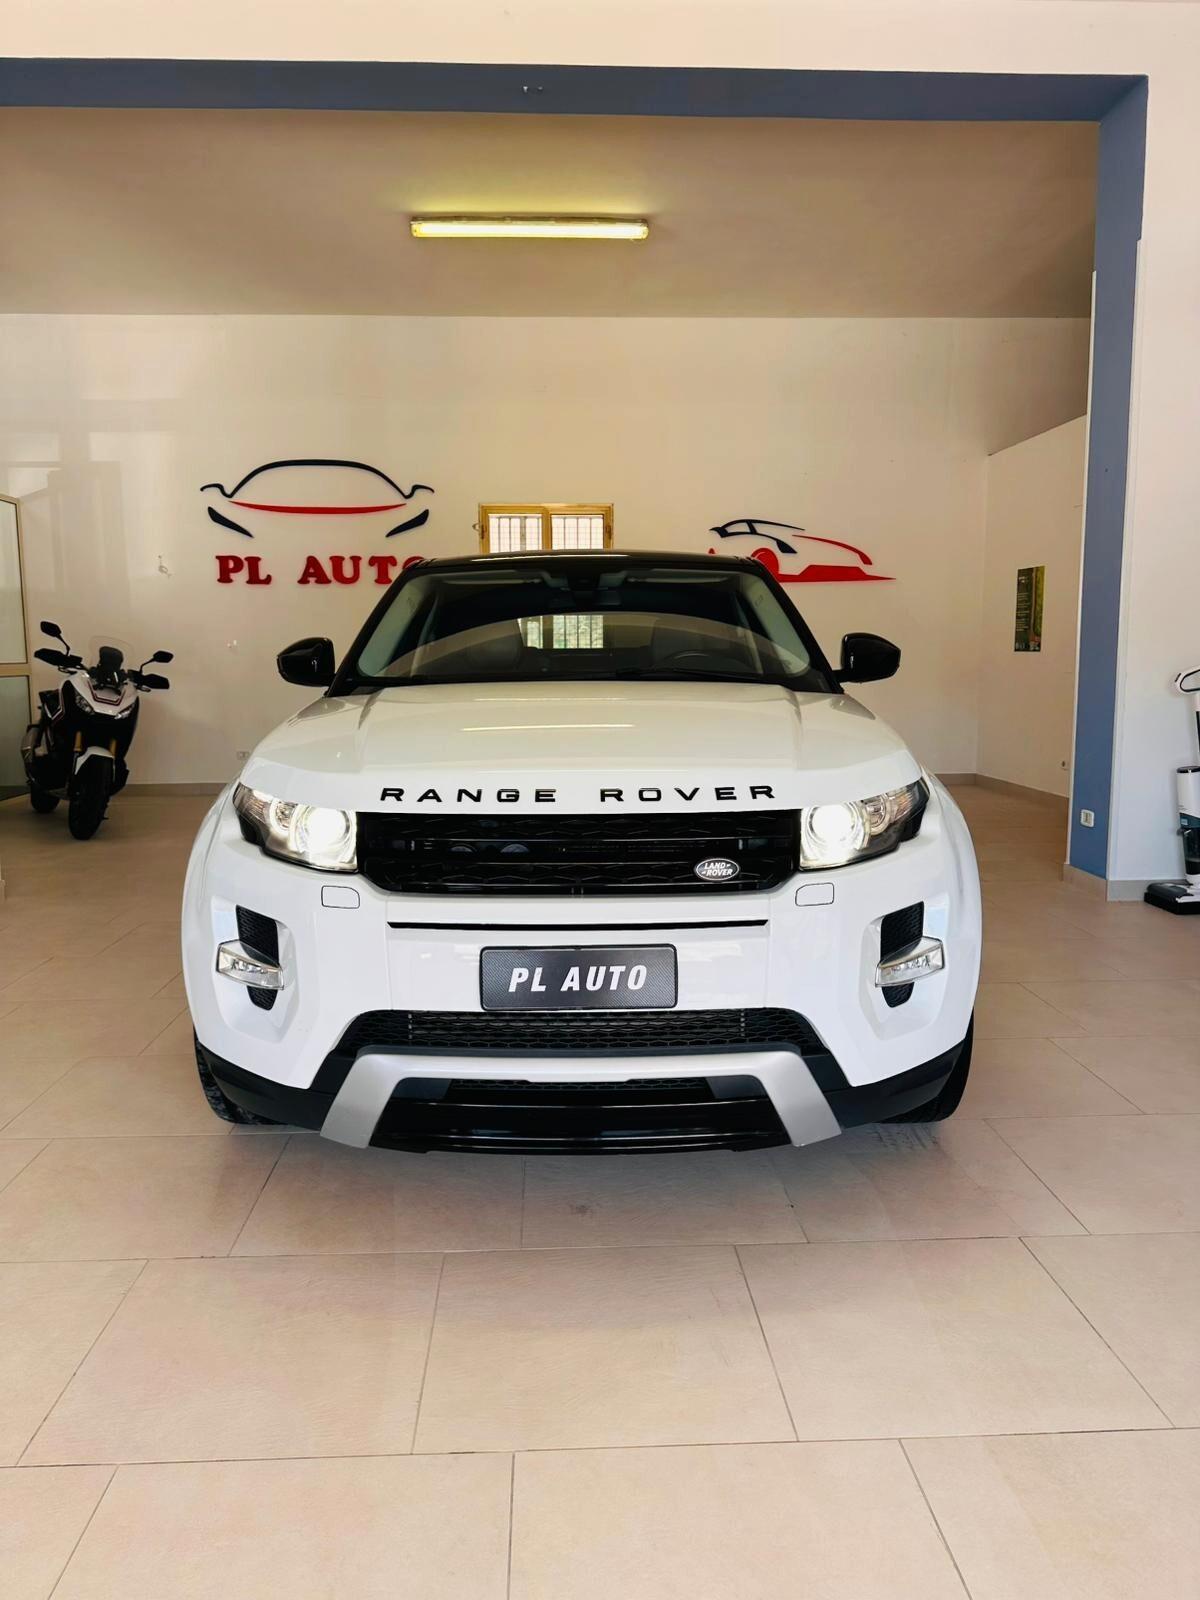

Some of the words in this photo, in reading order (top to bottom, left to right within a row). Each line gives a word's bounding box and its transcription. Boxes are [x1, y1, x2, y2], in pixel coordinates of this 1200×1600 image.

[215, 555, 272, 585] PL
[297, 555, 425, 585] AUT
[380, 787, 557, 803] RANGE
[600, 786, 775, 802] ROVER
[508, 967, 547, 993] PL
[560, 964, 648, 992] AUTO
